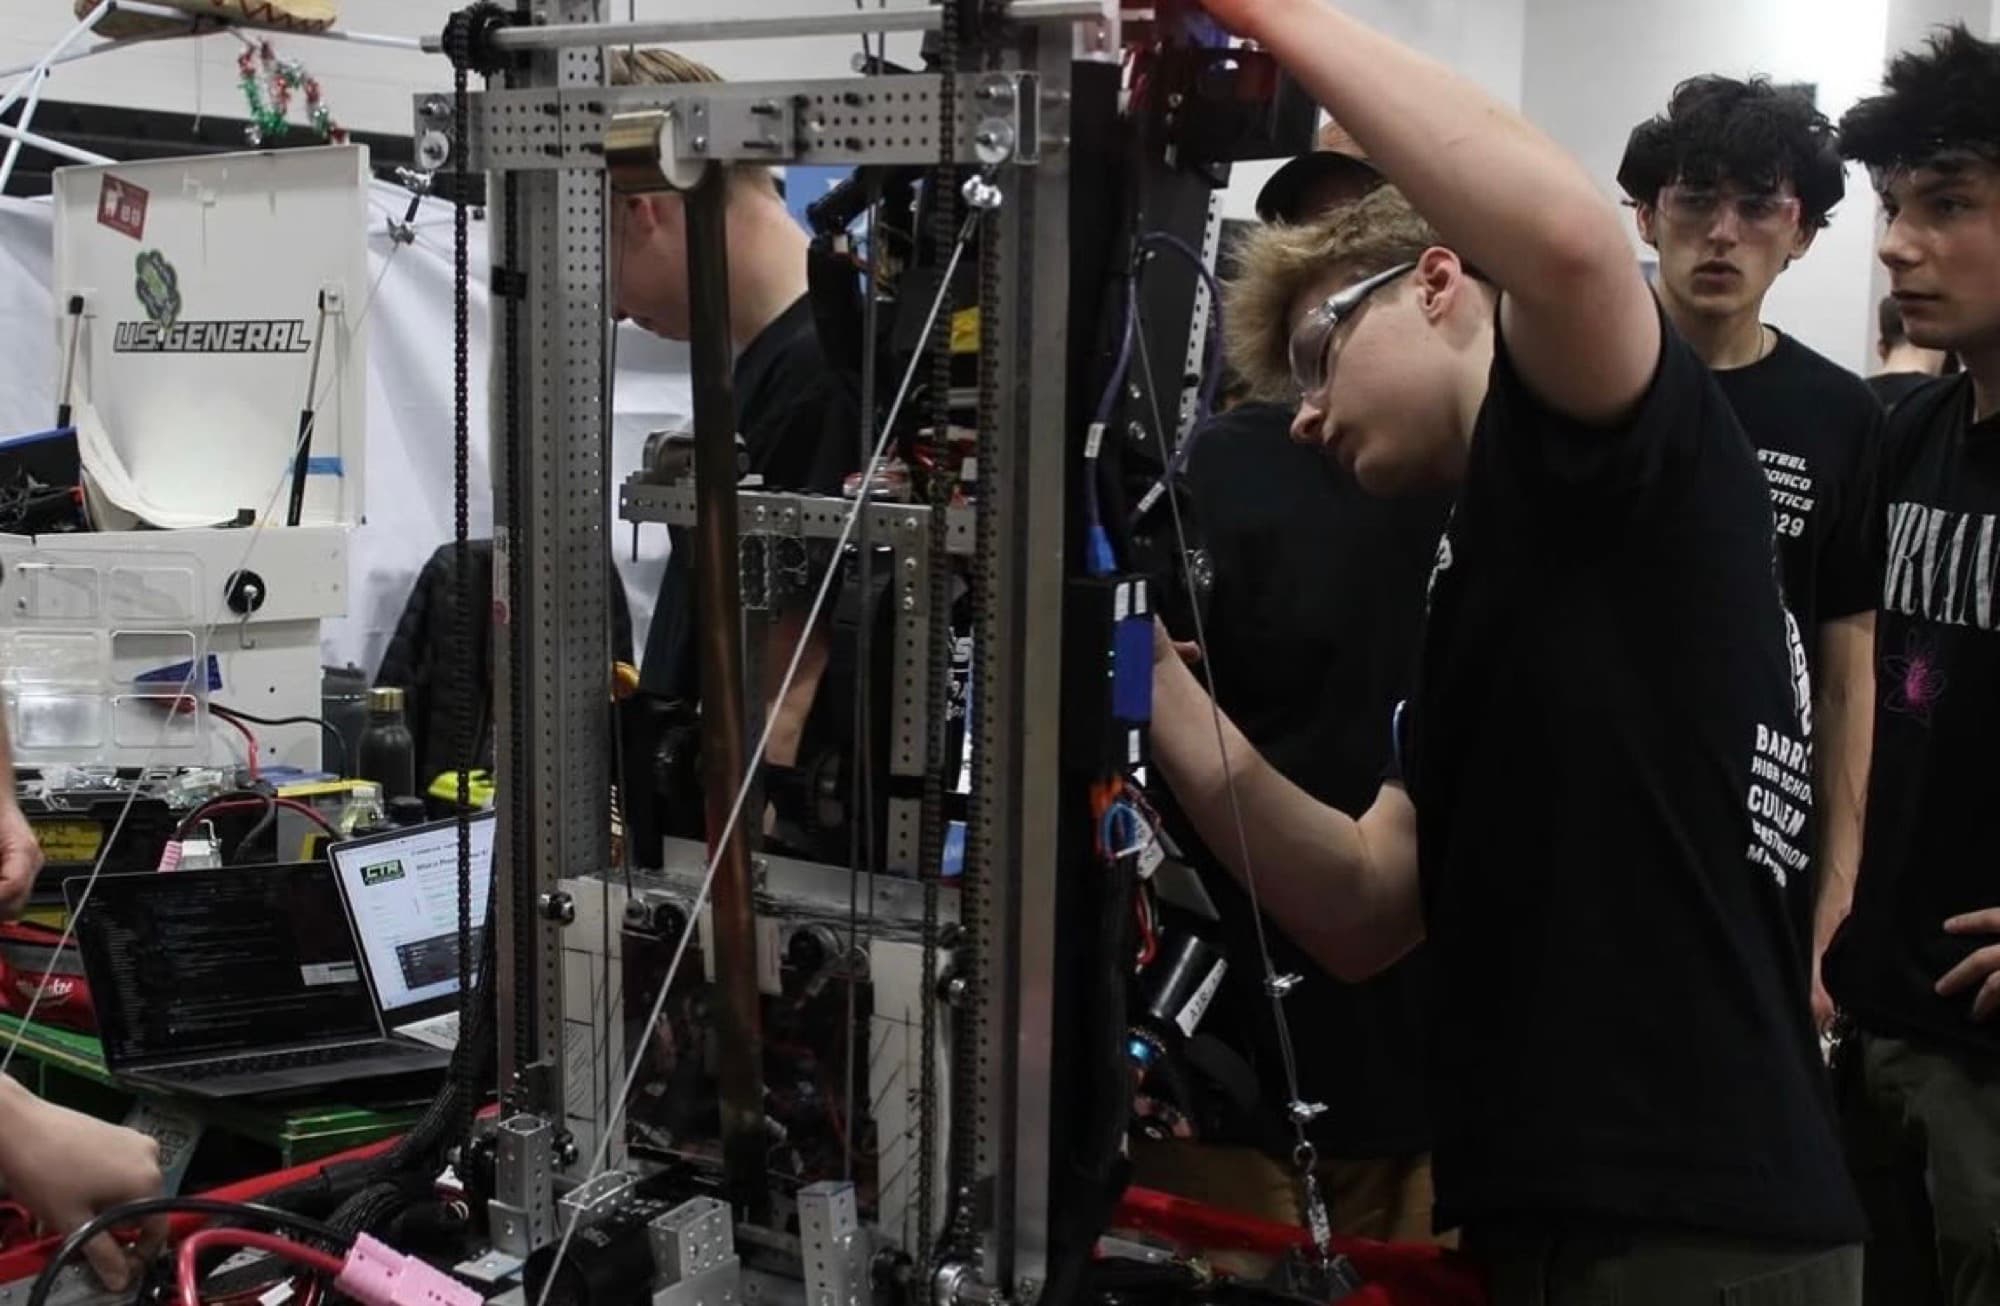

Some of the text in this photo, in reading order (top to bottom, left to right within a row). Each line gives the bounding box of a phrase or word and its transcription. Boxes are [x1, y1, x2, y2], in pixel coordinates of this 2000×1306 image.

[162, 319, 311, 353] GENERAL
[1757, 448, 1806, 471] STEEL
[1772, 511, 1805, 537] 29
[1747, 784, 1806, 837] CULLEN
